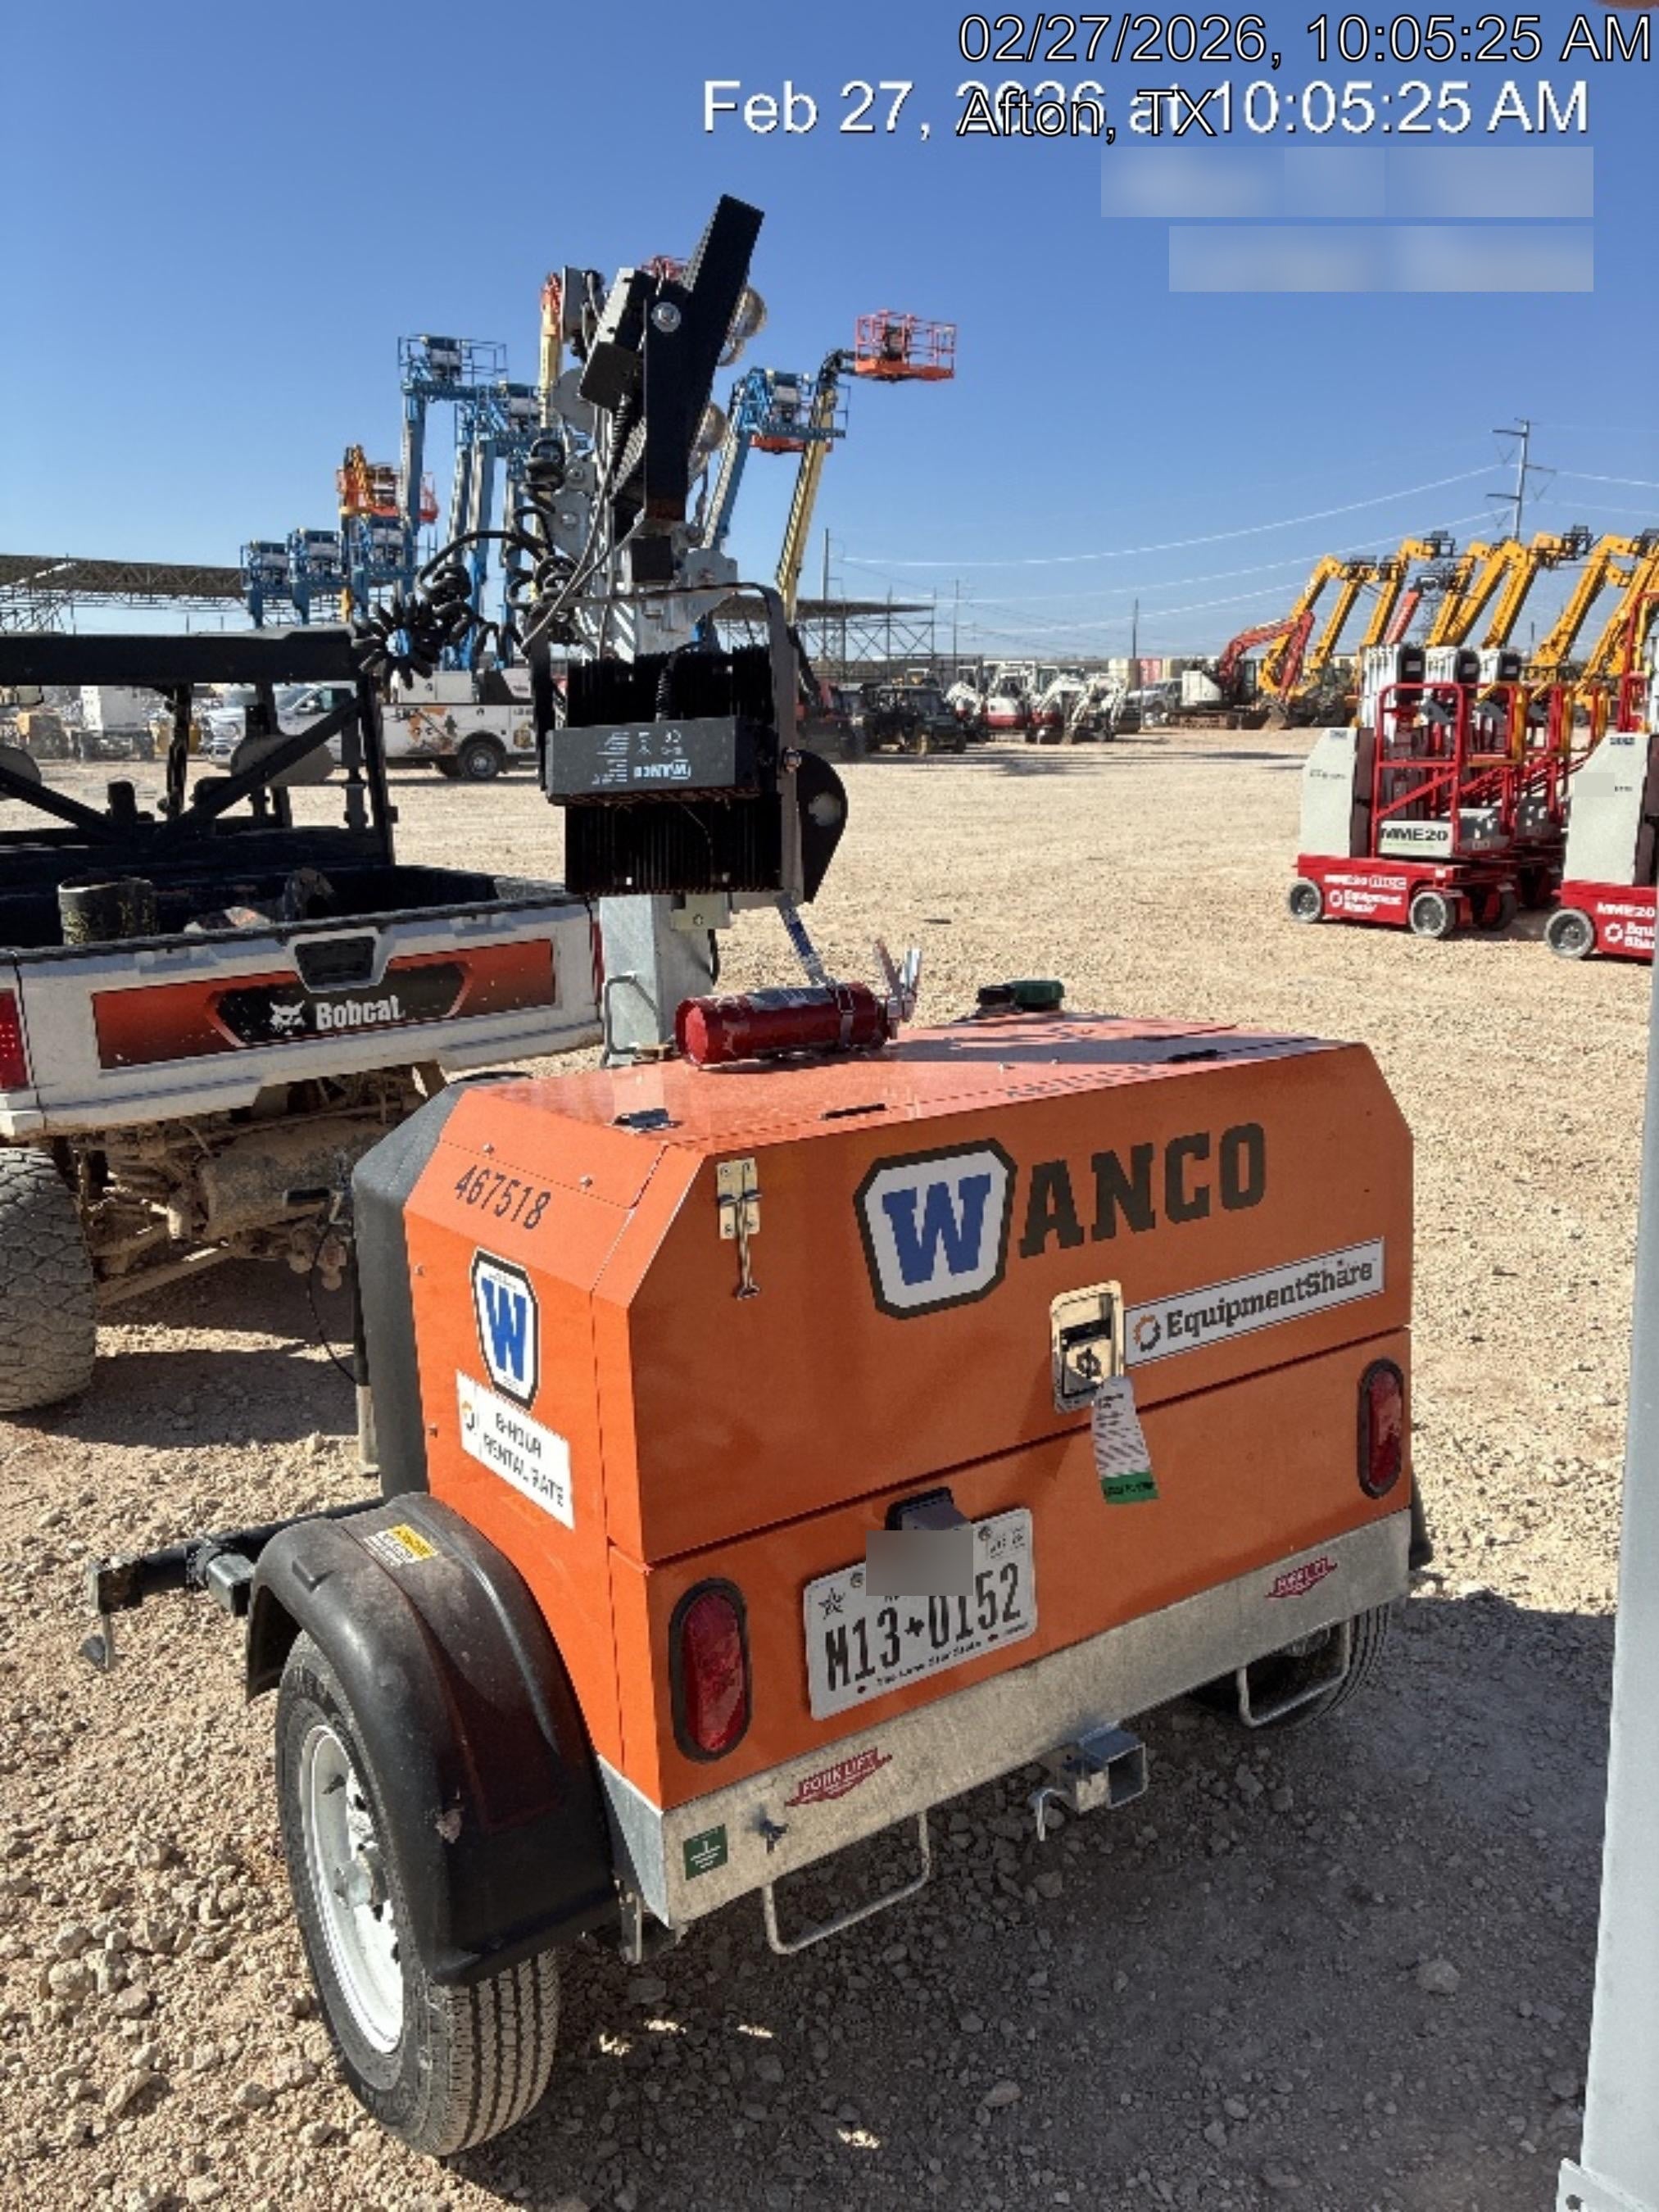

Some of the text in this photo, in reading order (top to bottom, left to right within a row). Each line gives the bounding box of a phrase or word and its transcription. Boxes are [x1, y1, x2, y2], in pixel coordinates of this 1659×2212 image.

[1381, 827, 1448, 842] MME20
[1597, 902, 1655, 918] MME20
[315, 995, 401, 1031] Bobcat
[454, 1164, 551, 1230] 467518
[882, 1122, 1266, 1286] WANCO
[481, 1276, 527, 1382] W
[1166, 1262, 1373, 1339] EquipmentShare
